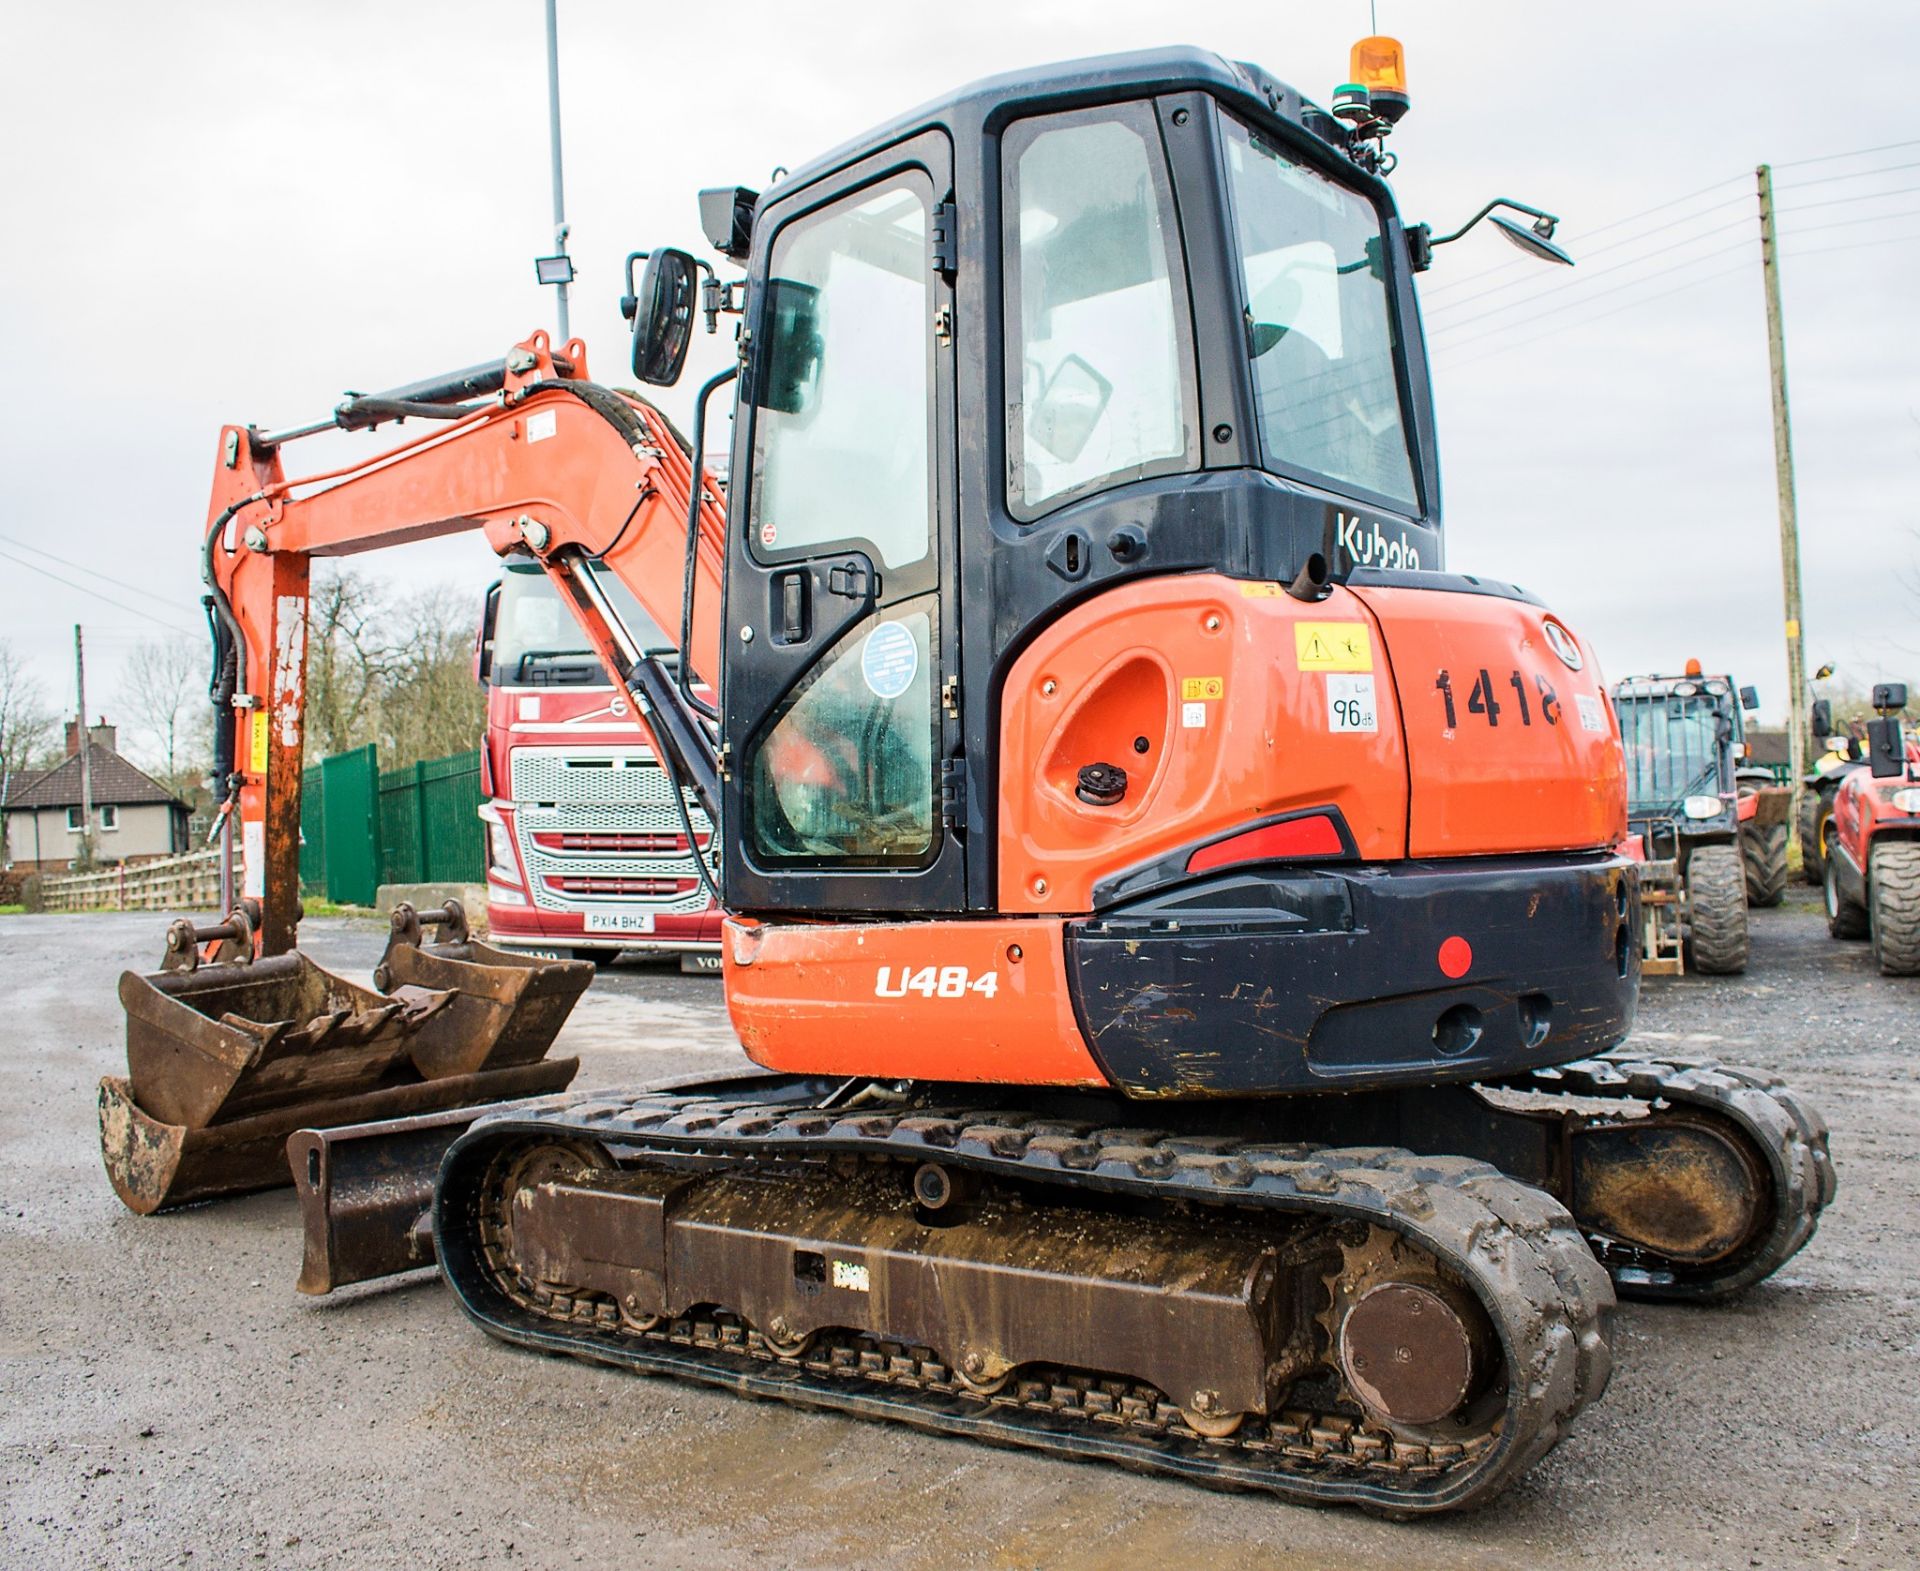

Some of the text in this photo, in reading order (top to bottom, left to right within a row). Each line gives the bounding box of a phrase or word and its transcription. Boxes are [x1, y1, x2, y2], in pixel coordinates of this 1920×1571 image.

[1337, 512, 1419, 570] Kubota
[592, 915, 645, 928] PX14 BHZ
[875, 966, 998, 998] U48-4
